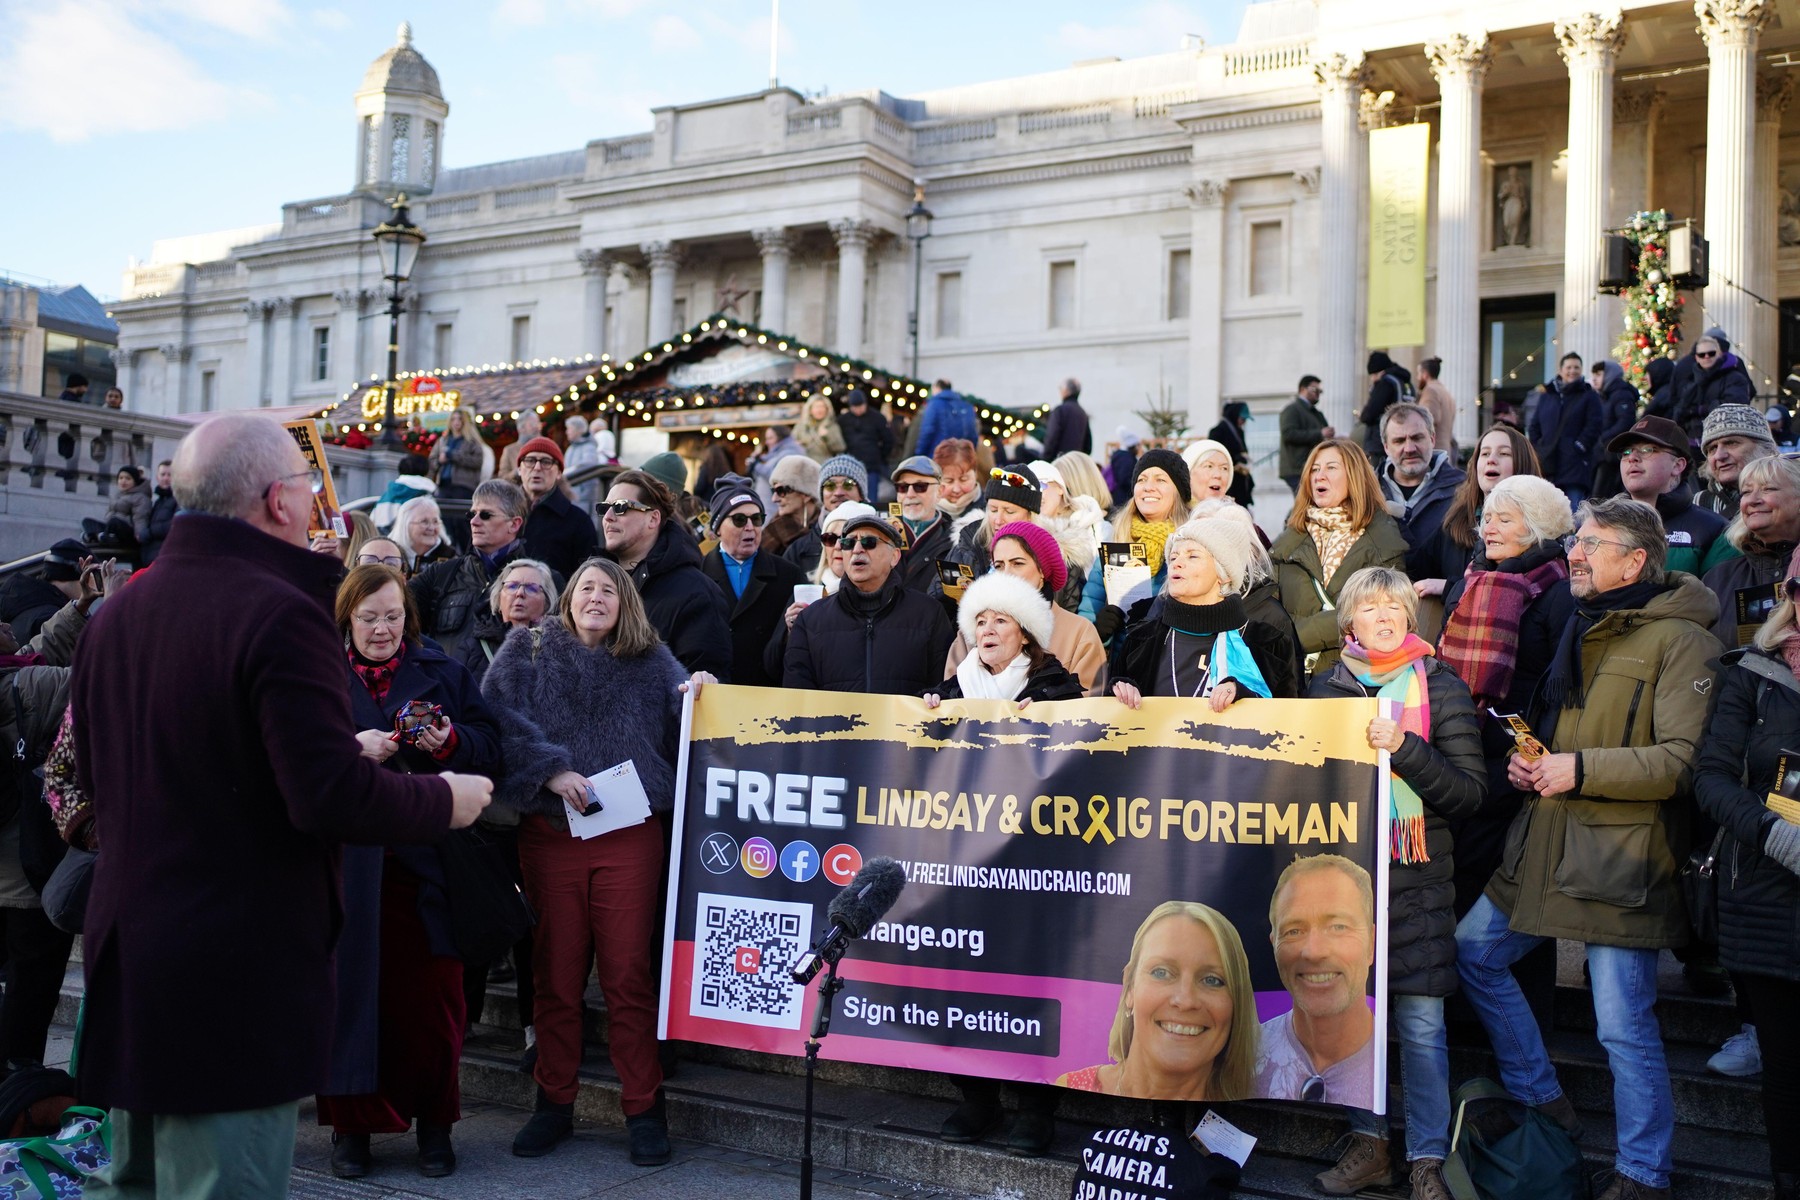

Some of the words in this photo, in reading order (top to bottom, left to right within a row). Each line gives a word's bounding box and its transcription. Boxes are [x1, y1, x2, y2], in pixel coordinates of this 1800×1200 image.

[1774, 772, 1784, 792] STAND
[705, 767, 847, 828] FREE
[856, 786, 997, 832] LINDSAY
[998, 794, 1024, 835] &
[1160, 798, 1358, 844] FOREMAN
[896, 860, 1131, 896] W.FREELINDSAYANDCRAIG.COM
[863, 921, 984, 956] ange.org
[843, 996, 896, 1026] Sign
[903, 1003, 939, 1027] the
[947, 1007, 1041, 1037] Petition
[1092, 1128, 1176, 1159] LIGHTS.
[1082, 1147, 1174, 1190] CAMERA.
[1075, 1180, 1167, 1200] SPAR
